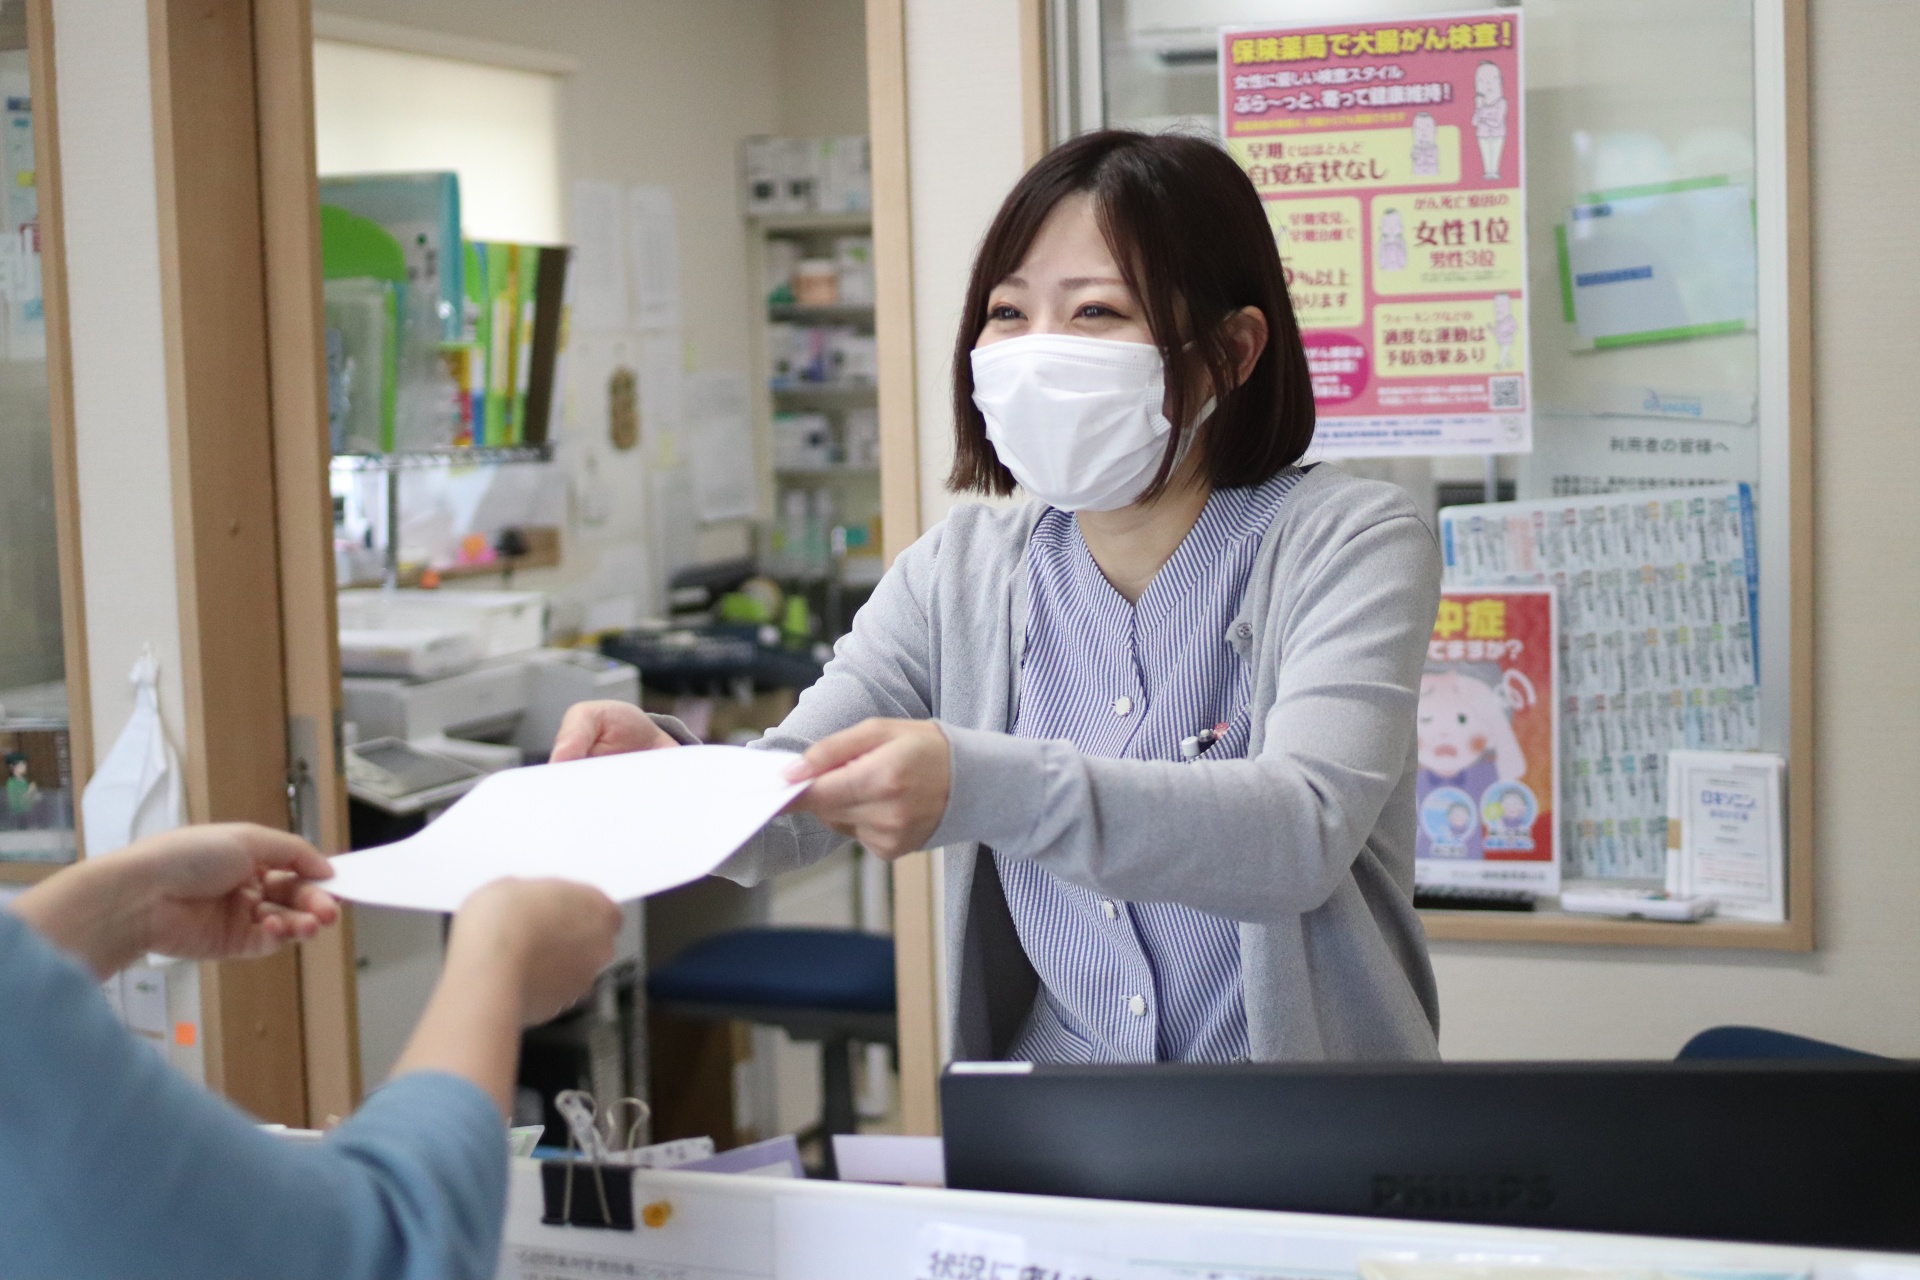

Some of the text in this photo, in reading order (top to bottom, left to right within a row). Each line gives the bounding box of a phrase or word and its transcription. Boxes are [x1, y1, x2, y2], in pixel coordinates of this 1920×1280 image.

[1248, 159, 1388, 186] 自覚症状なし
[1413, 217, 1511, 248] 女性1位
[1430, 250, 1496, 268] 男性3位
[1386, 347, 1486, 366] 予防効果あり
[1371, 1173, 1556, 1210] PHILIPS
